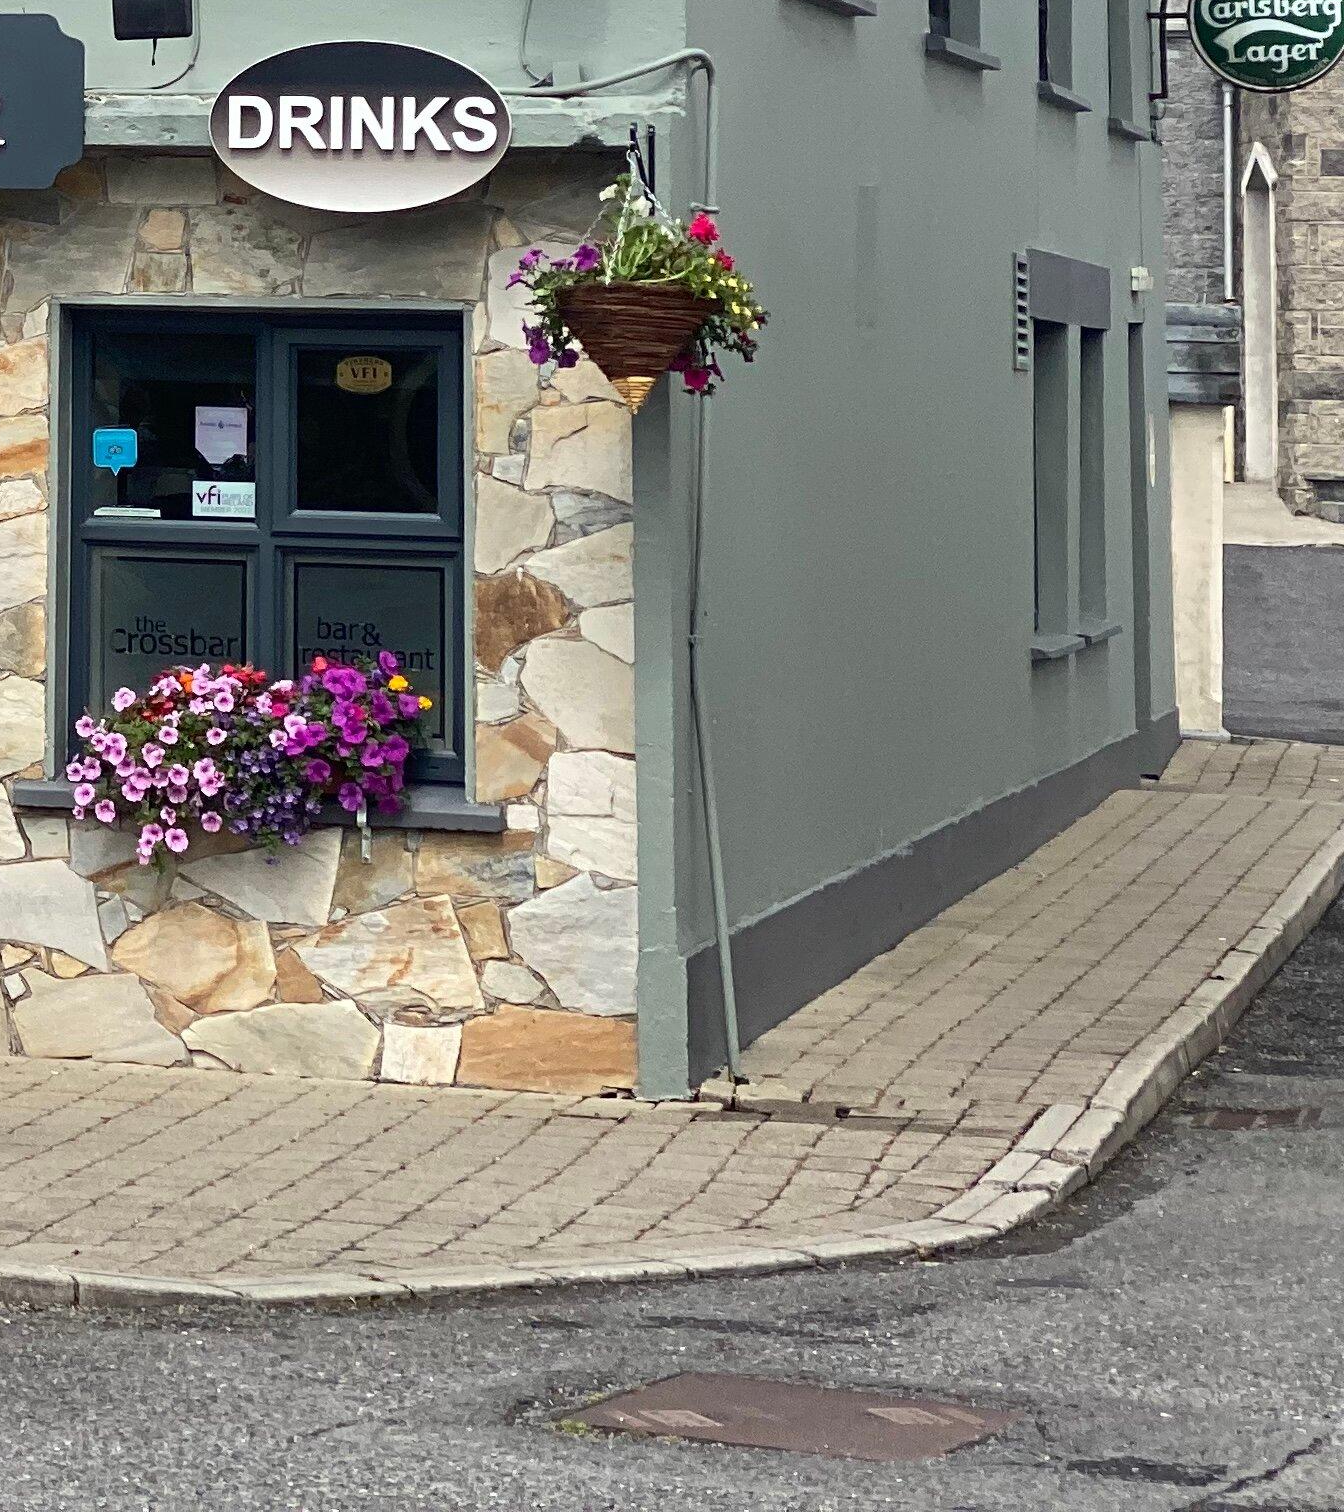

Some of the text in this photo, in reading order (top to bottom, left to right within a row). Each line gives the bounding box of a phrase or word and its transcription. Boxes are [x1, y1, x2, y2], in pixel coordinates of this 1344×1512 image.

[1217, 37, 1325, 74] Lager
[226, 94, 499, 155] DRINKS
[350, 367, 378, 379] VFI
[195, 484, 222, 506] vfi
[135, 615, 167, 634] the
[316, 616, 383, 647] bar &
